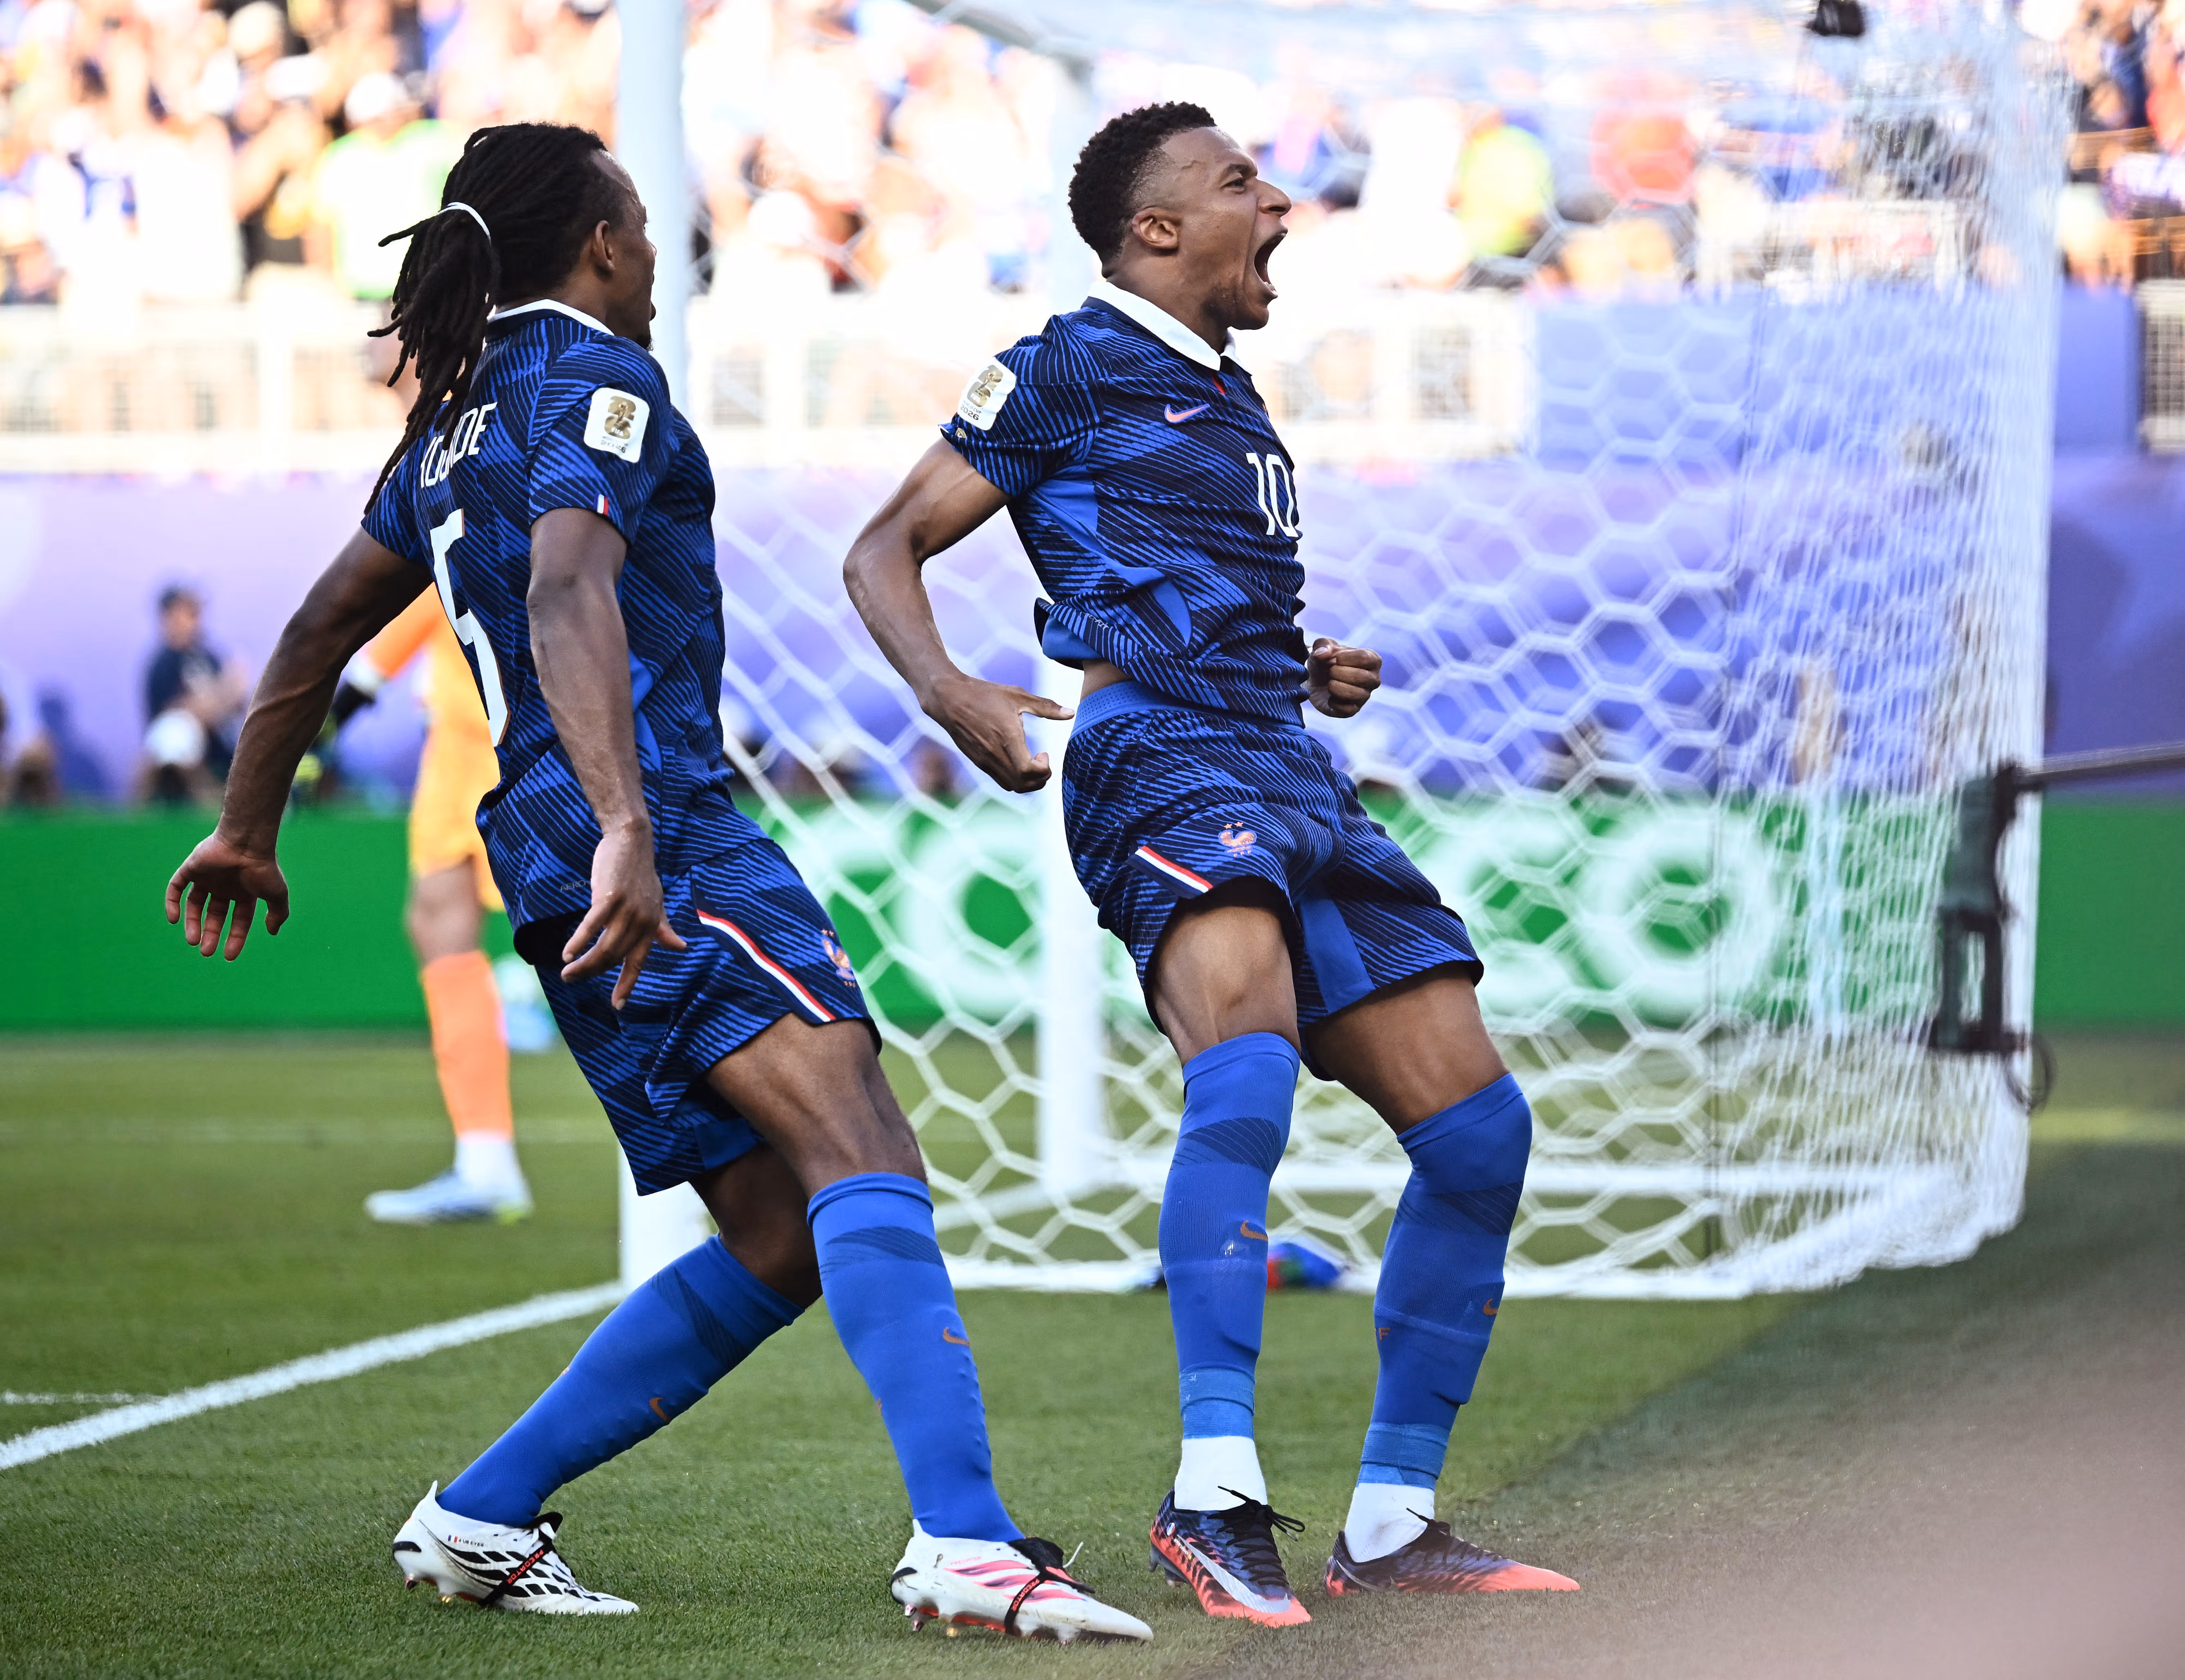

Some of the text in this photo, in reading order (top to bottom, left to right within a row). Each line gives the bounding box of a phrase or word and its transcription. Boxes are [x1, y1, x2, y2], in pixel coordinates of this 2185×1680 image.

[960, 404, 979, 420] 2026
[601, 440, 626, 453] 2026
[611, 427, 624, 436] FIFA
[1246, 453, 1299, 537] 10
[430, 508, 511, 747] 5
[506, 1549, 544, 1584] PREDATOR
[1012, 1578, 1040, 1612] PREDATOR
